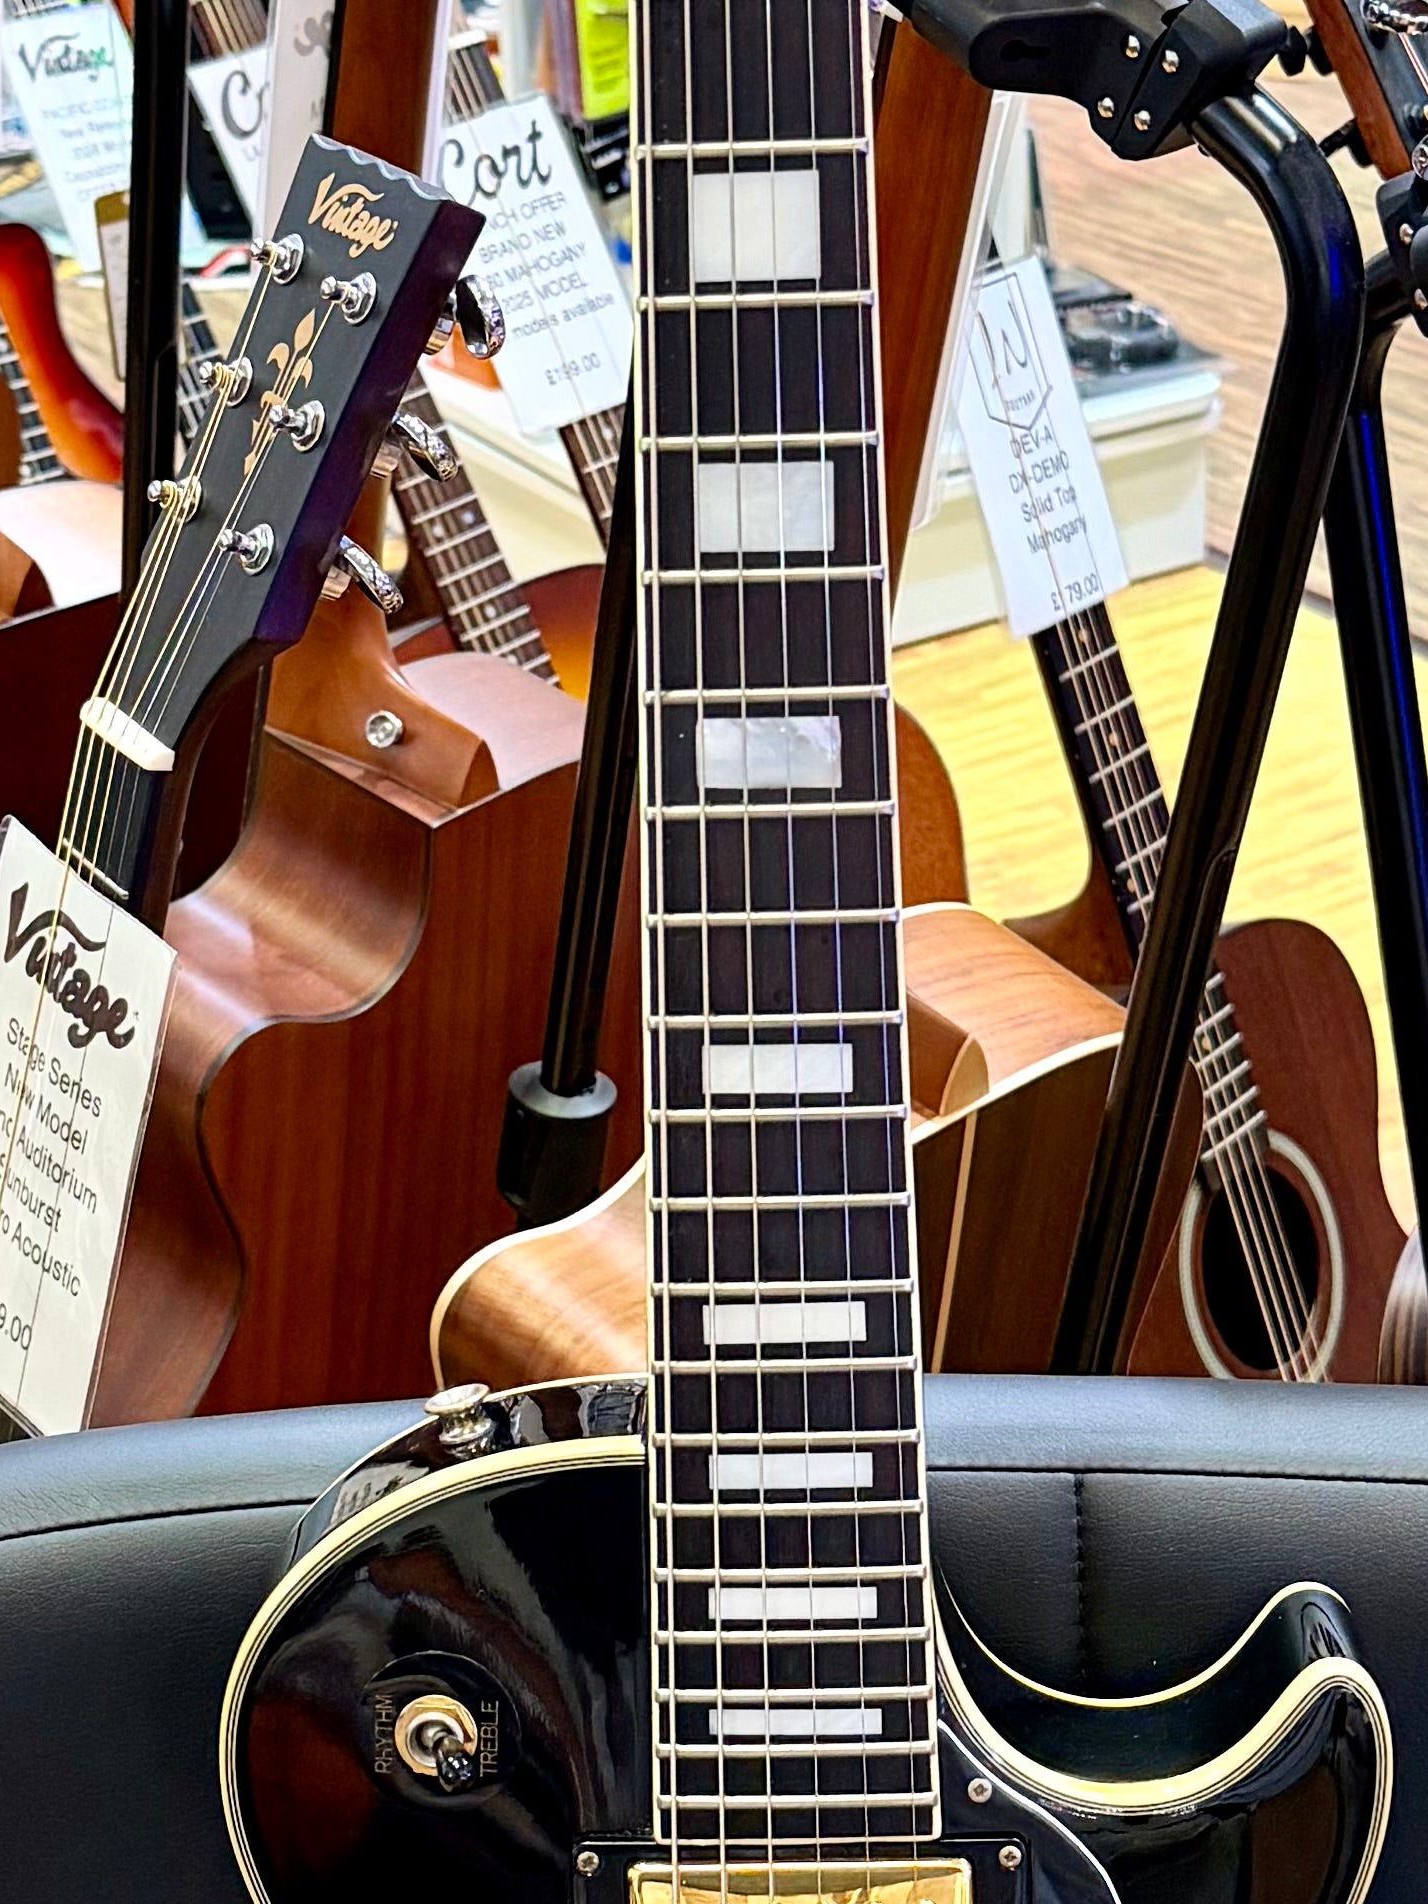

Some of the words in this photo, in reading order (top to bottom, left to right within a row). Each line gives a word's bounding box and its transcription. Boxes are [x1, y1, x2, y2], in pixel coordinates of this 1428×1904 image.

[438, 118, 552, 207] Cort
[308, 172, 399, 258] Vintage
[522, 192, 566, 221] OFFER
[478, 233, 532, 264] BRAND
[534, 221, 568, 243] NEW
[537, 272, 588, 302] MODEL
[1021, 496, 1053, 524] Solid
[1027, 514, 1087, 554] Mahogany
[1051, 573, 1100, 612] £79.00
[5, 882, 135, 1050] Vintage
[7, 1017, 45, 1073] Stage
[48, 1057, 102, 1118] Series
[36, 1094, 88, 1155] Model
[16, 1126, 98, 1214] Auditorium
[11, 1222, 81, 1297] Acoustic
